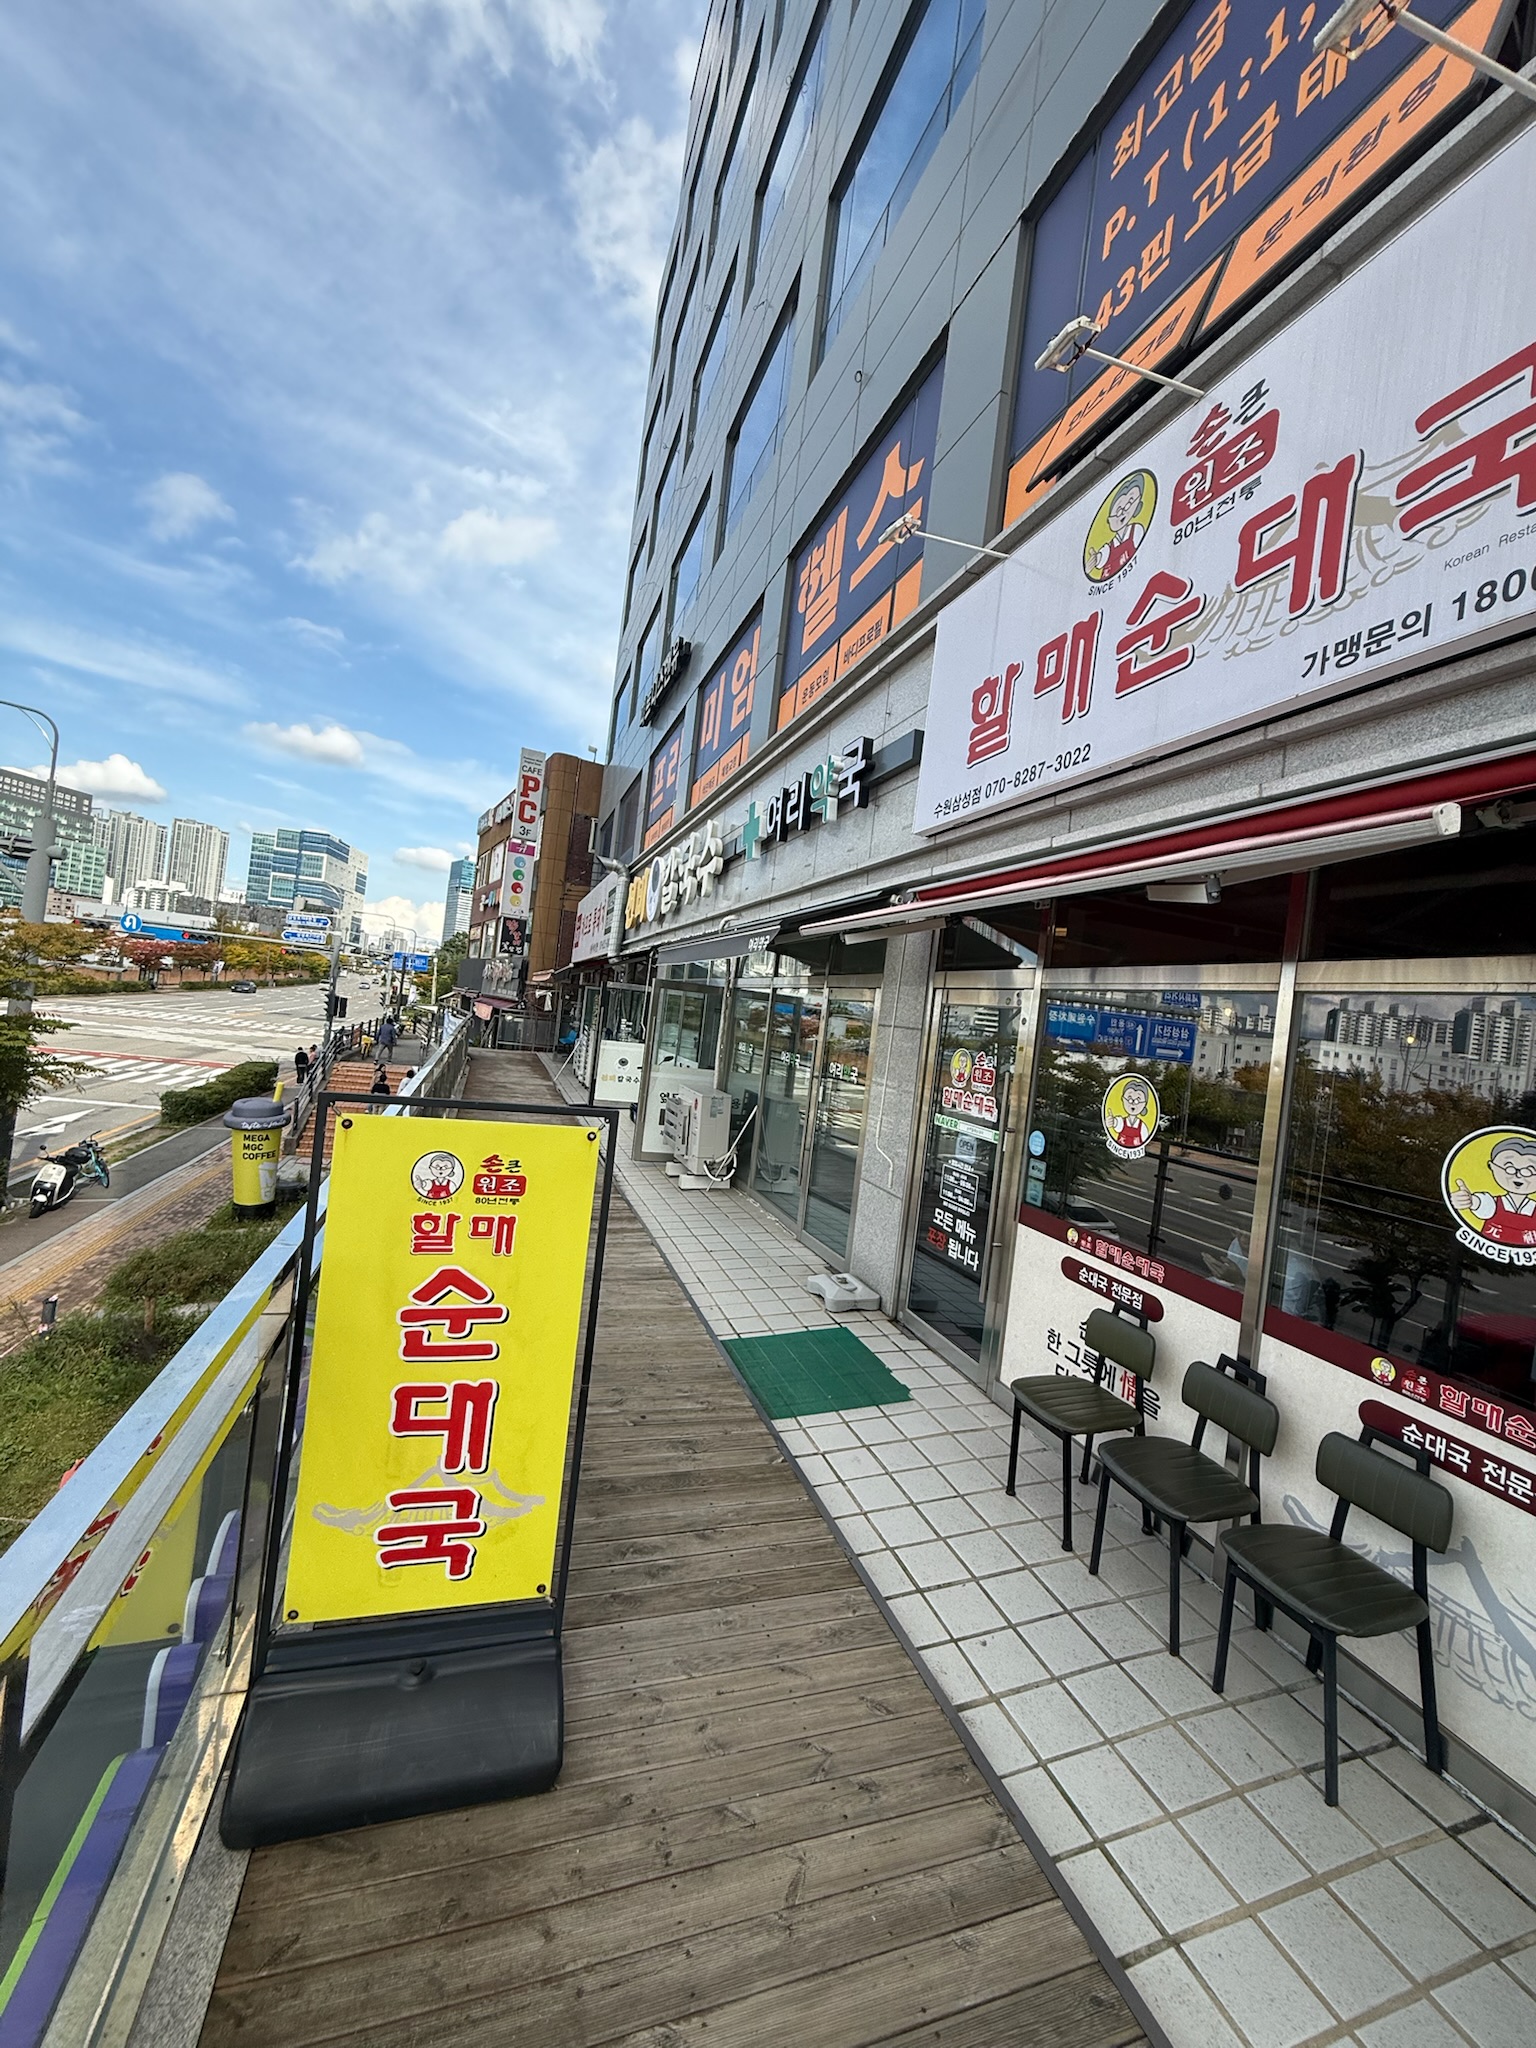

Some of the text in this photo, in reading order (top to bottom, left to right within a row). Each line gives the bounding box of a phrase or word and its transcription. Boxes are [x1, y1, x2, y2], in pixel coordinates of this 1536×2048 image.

[1110, 0, 1231, 180] 최고급
[1095, 213, 1175, 332] 43핀
[1184, 100, 1280, 243] 고급
[1179, 431, 1266, 510] 원조
[1173, 475, 1263, 546] 80년전통
[797, 440, 925, 655] 헬스
[965, 338, 1536, 768] 할매순대국
[1444, 544, 1490, 571] Korean
[1088, 579, 1114, 596] SINCE
[843, 616, 883, 664] 바디프로필
[1301, 569, 1536, 678] 가맹문의 180
[521, 764, 543, 776] CAFE
[766, 736, 874, 842] 여리약국
[934, 743, 1091, 818] 수원삼성점 070-8287-3022
[518, 774, 542, 824] PC
[519, 825, 532, 836] 3F
[243, 1133, 271, 1142] MEGA
[935, 1114, 959, 1129] NAVER
[242, 1150, 276, 1160] COFFEE
[243, 1143, 264, 1151] MGC
[480, 1154, 522, 1173] 손큰
[959, 1138, 975, 1151] OPEN
[1108, 1140, 1127, 1157] SINCE
[1129, 1147, 1144, 1158] 1937
[417, 1197, 438, 1206] SINCE
[477, 1176, 521, 1194] 원조
[411, 1212, 518, 1256] 할매
[933, 1208, 954, 1233] 모든
[955, 1219, 976, 1245] 메뉴
[1459, 1230, 1508, 1261] SINCE
[927, 1227, 980, 1272] 포장 됩니다
[1096, 1239, 1166, 1284] 할매순대국
[1078, 1266, 1144, 1311] 순대국 전문점
[1047, 1328, 1062, 1355] 한
[1402, 1423, 1472, 1474] 순대국
